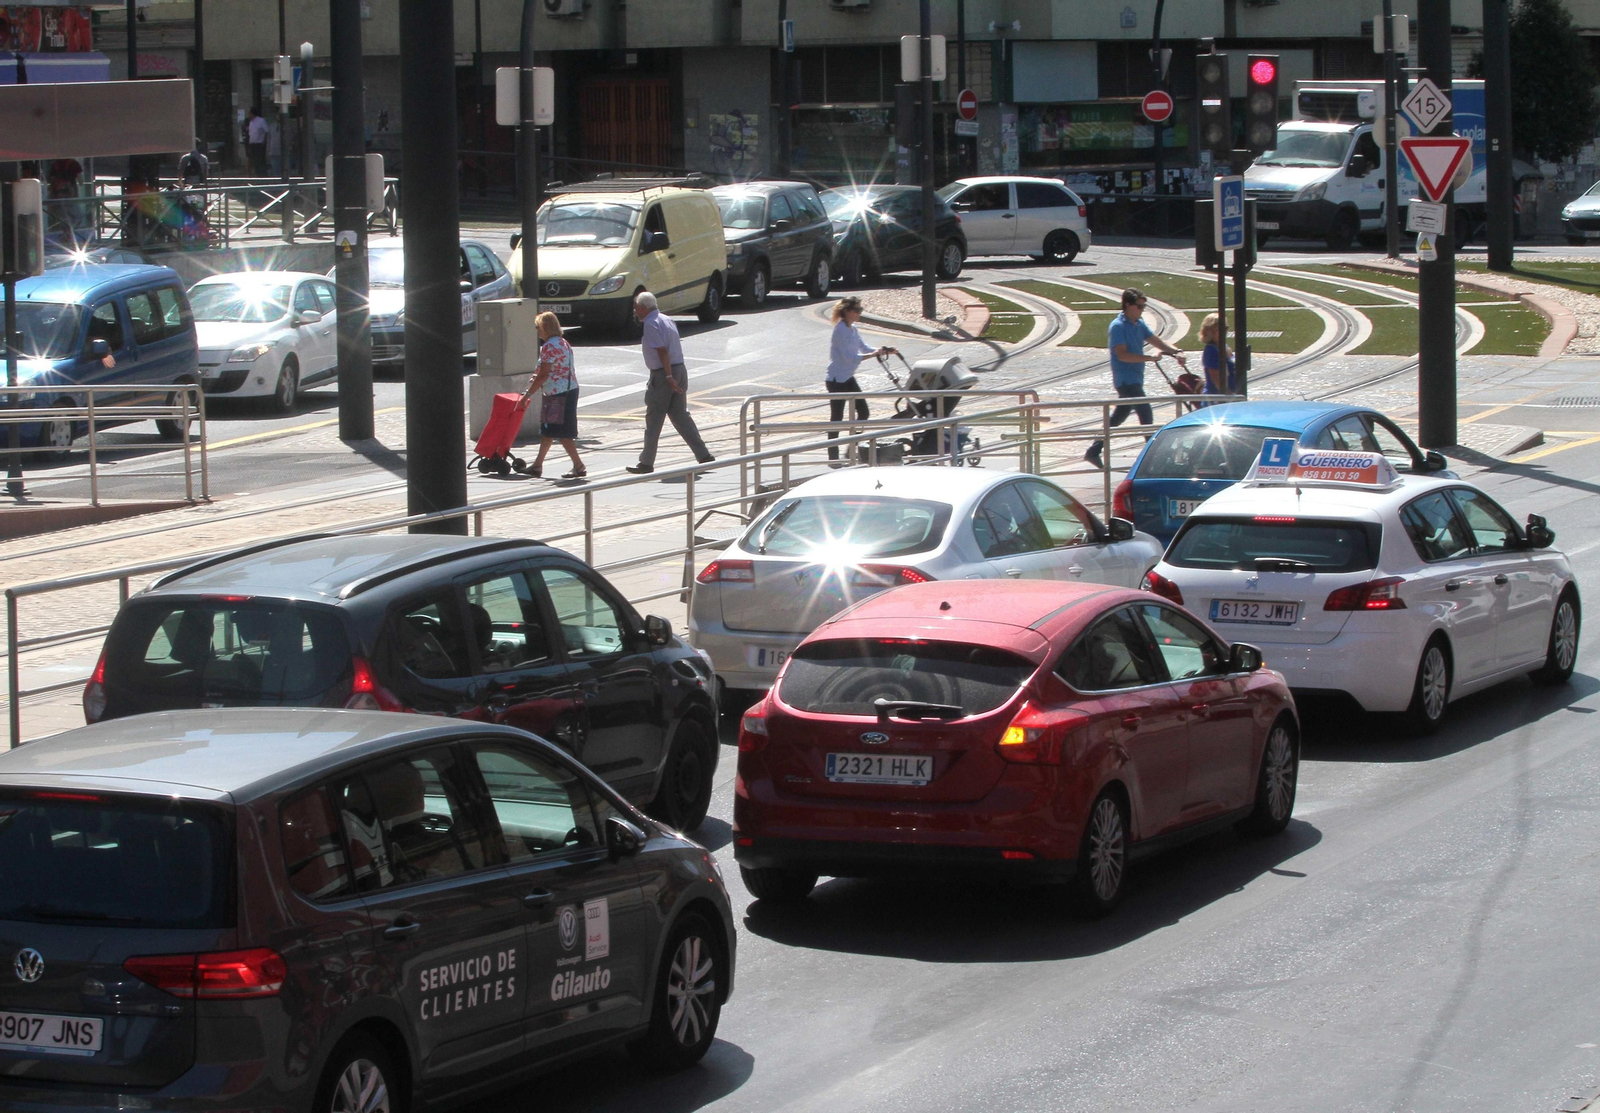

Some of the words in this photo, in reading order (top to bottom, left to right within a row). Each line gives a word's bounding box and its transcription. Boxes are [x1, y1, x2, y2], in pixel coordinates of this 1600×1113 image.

[1415, 97, 1436, 115] 15
[1269, 443, 1281, 463] L
[1297, 453, 1373, 469] GUERRERO
[1315, 451, 1374, 459] AUTOESCUELA
[1258, 466, 1286, 476] PRACTICAS
[1301, 470, 1319, 480] 858
[1320, 470, 1332, 480] 81
[1334, 471, 1347, 481] 03
[1347, 472, 1360, 481] 50
[1221, 602, 1261, 619] 6132
[1264, 604, 1295, 620] JWH
[838, 756, 883, 776] 2321
[891, 758, 928, 778] HLK
[588, 933, 602, 943] Audi
[588, 943, 607, 955] Service
[420, 954, 492, 992] SERVICIO
[497, 948, 517, 973] DE
[550, 964, 612, 1002] Gilauto
[420, 976, 516, 1021] CLIENTES
[0, 1015, 45, 1042] 907
[52, 1019, 94, 1046] JNS
